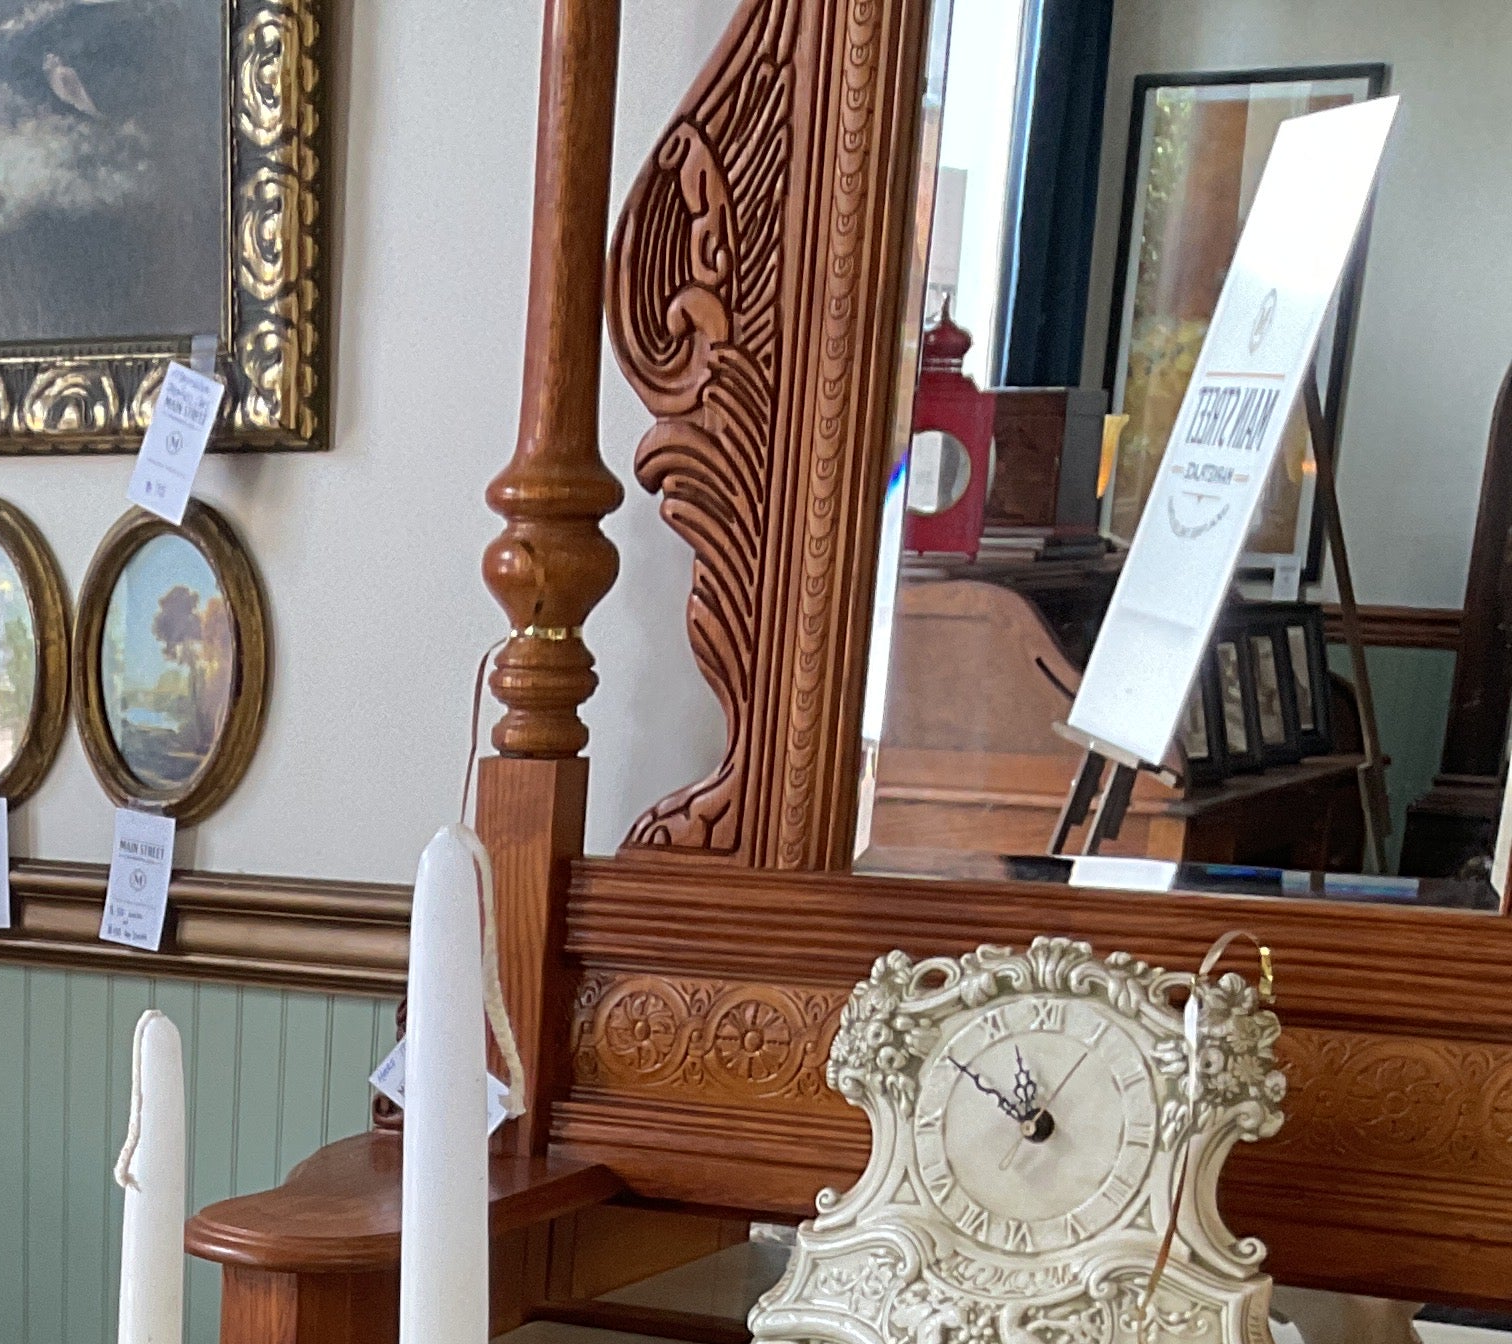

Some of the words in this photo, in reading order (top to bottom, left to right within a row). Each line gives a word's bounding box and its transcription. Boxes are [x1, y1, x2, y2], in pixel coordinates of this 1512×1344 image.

[120, 840, 138, 854] MAIN
[140, 844, 164, 860] STREET
[1030, 999, 1065, 1032] XII
